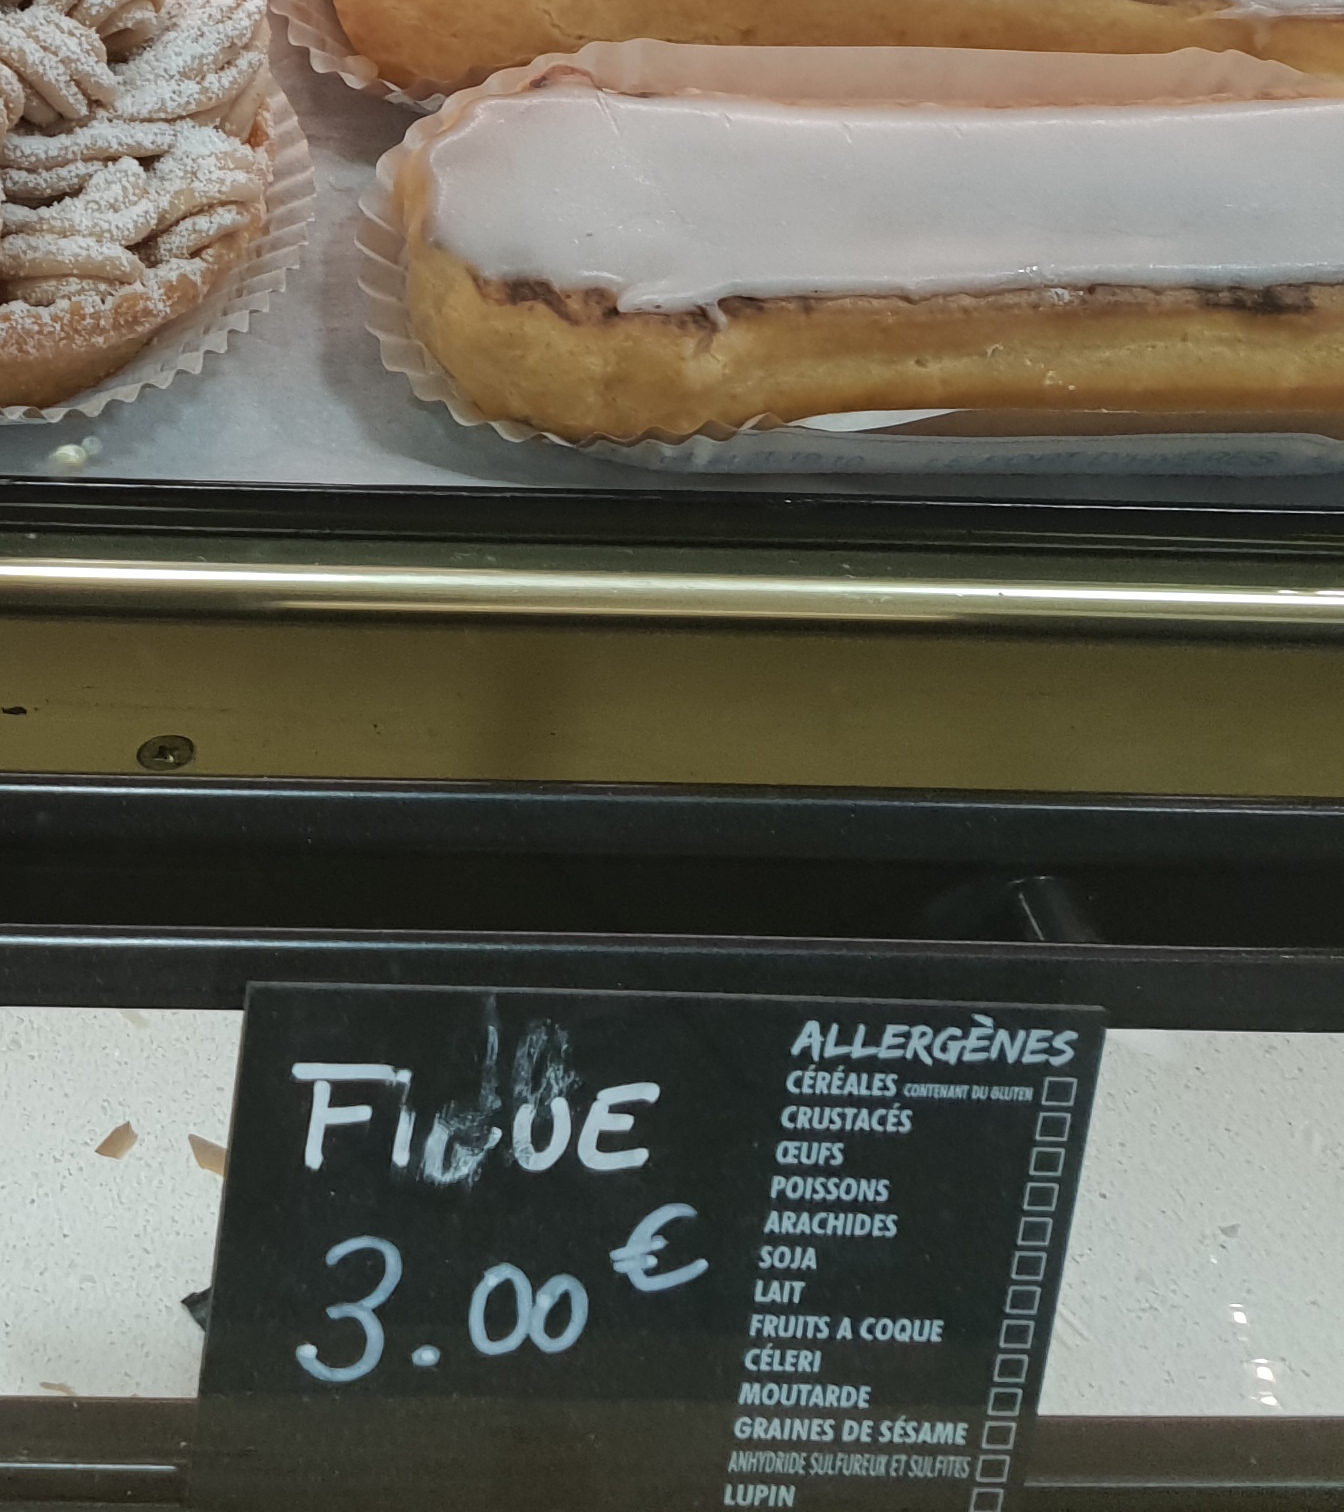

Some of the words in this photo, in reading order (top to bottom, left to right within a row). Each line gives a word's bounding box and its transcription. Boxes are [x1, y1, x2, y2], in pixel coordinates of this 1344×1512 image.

[790, 1013, 1078, 1067] ALLERGÈNES
[786, 1065, 898, 1097] CÉRÉALES
[903, 1083, 969, 1100] CONTENANT
[971, 1085, 989, 1100] DU
[990, 1086, 1033, 1101] GLUTEN
[781, 1103, 913, 1133] CRUSTACÉS
[775, 1140, 844, 1166] ŒUFS
[770, 1175, 890, 1202] POISSONS
[763, 1211, 898, 1238] ARACHIDES
[609, 1203, 709, 1291] €
[758, 1246, 817, 1270] SOJA
[754, 1279, 806, 1304] LAIT
[749, 1314, 830, 1339] FRUITS
[836, 1317, 852, 1340] A
[859, 1317, 944, 1343] COQUE
[744, 1343, 822, 1373] CÉLERI
[738, 1383, 871, 1409] MOUTARDE
[733, 1416, 835, 1442] GRAINES
[841, 1420, 874, 1443] DE
[879, 1416, 968, 1445] SÉSAME
[727, 1451, 807, 1475] ANHYDRIDE
[810, 1453, 888, 1477] SULFUREUX
[889, 1454, 907, 1477] ET
[909, 1455, 971, 1479] SULFITES
[723, 1483, 795, 1507] LUPIN
